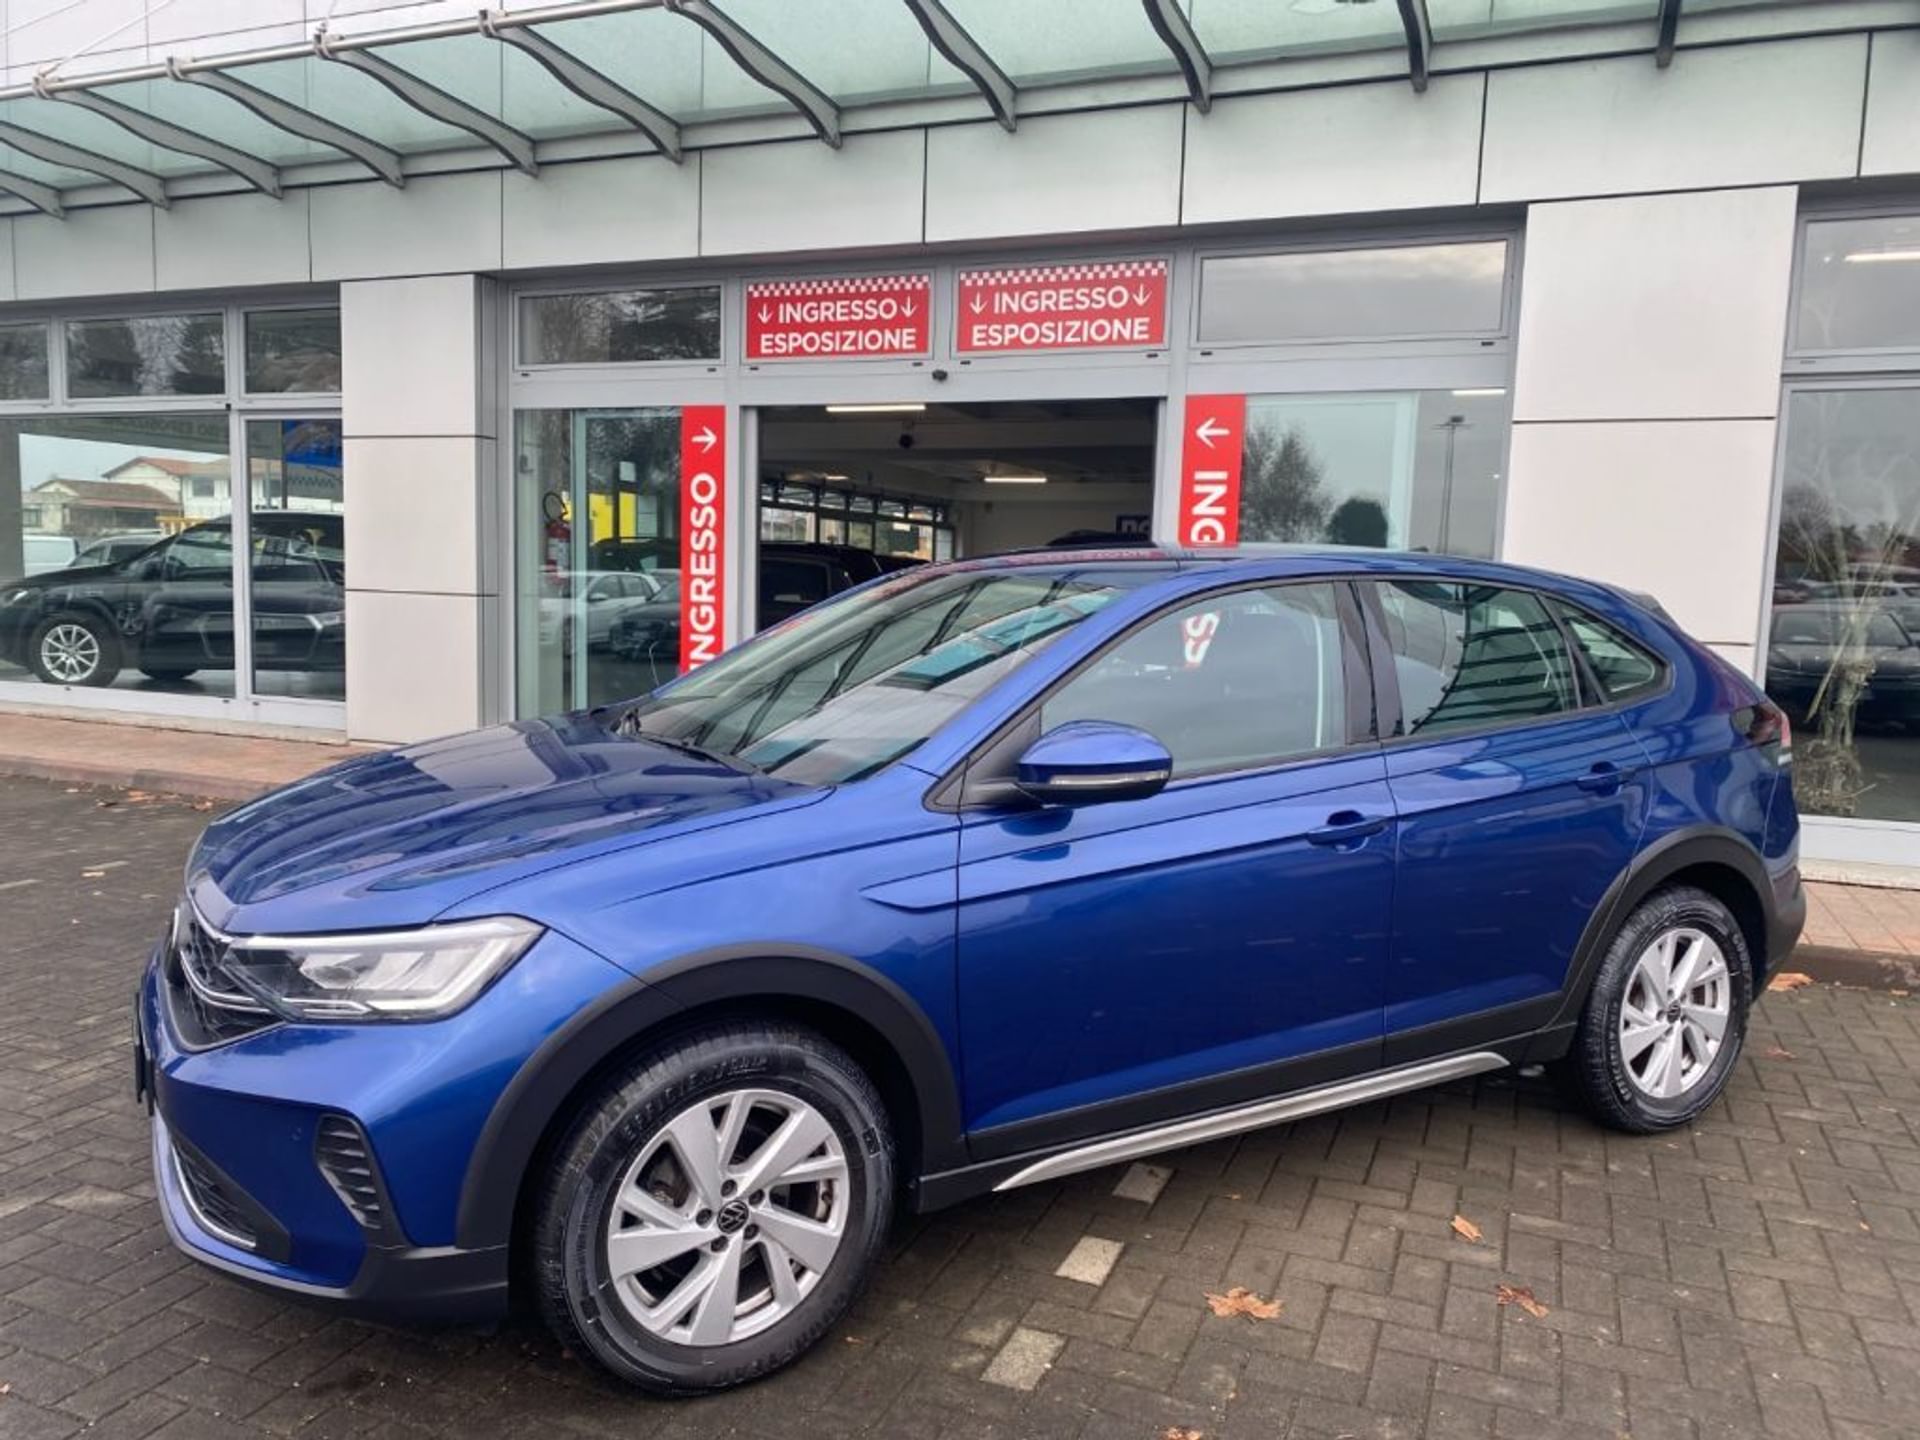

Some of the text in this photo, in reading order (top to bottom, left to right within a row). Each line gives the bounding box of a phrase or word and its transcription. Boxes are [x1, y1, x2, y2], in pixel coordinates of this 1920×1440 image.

[779, 298, 897, 323] INGRESSO
[994, 285, 1129, 314] INGRESSO
[760, 328, 916, 354] ESPOSIZIONE
[972, 317, 1150, 346] ESPOSIZIONE
